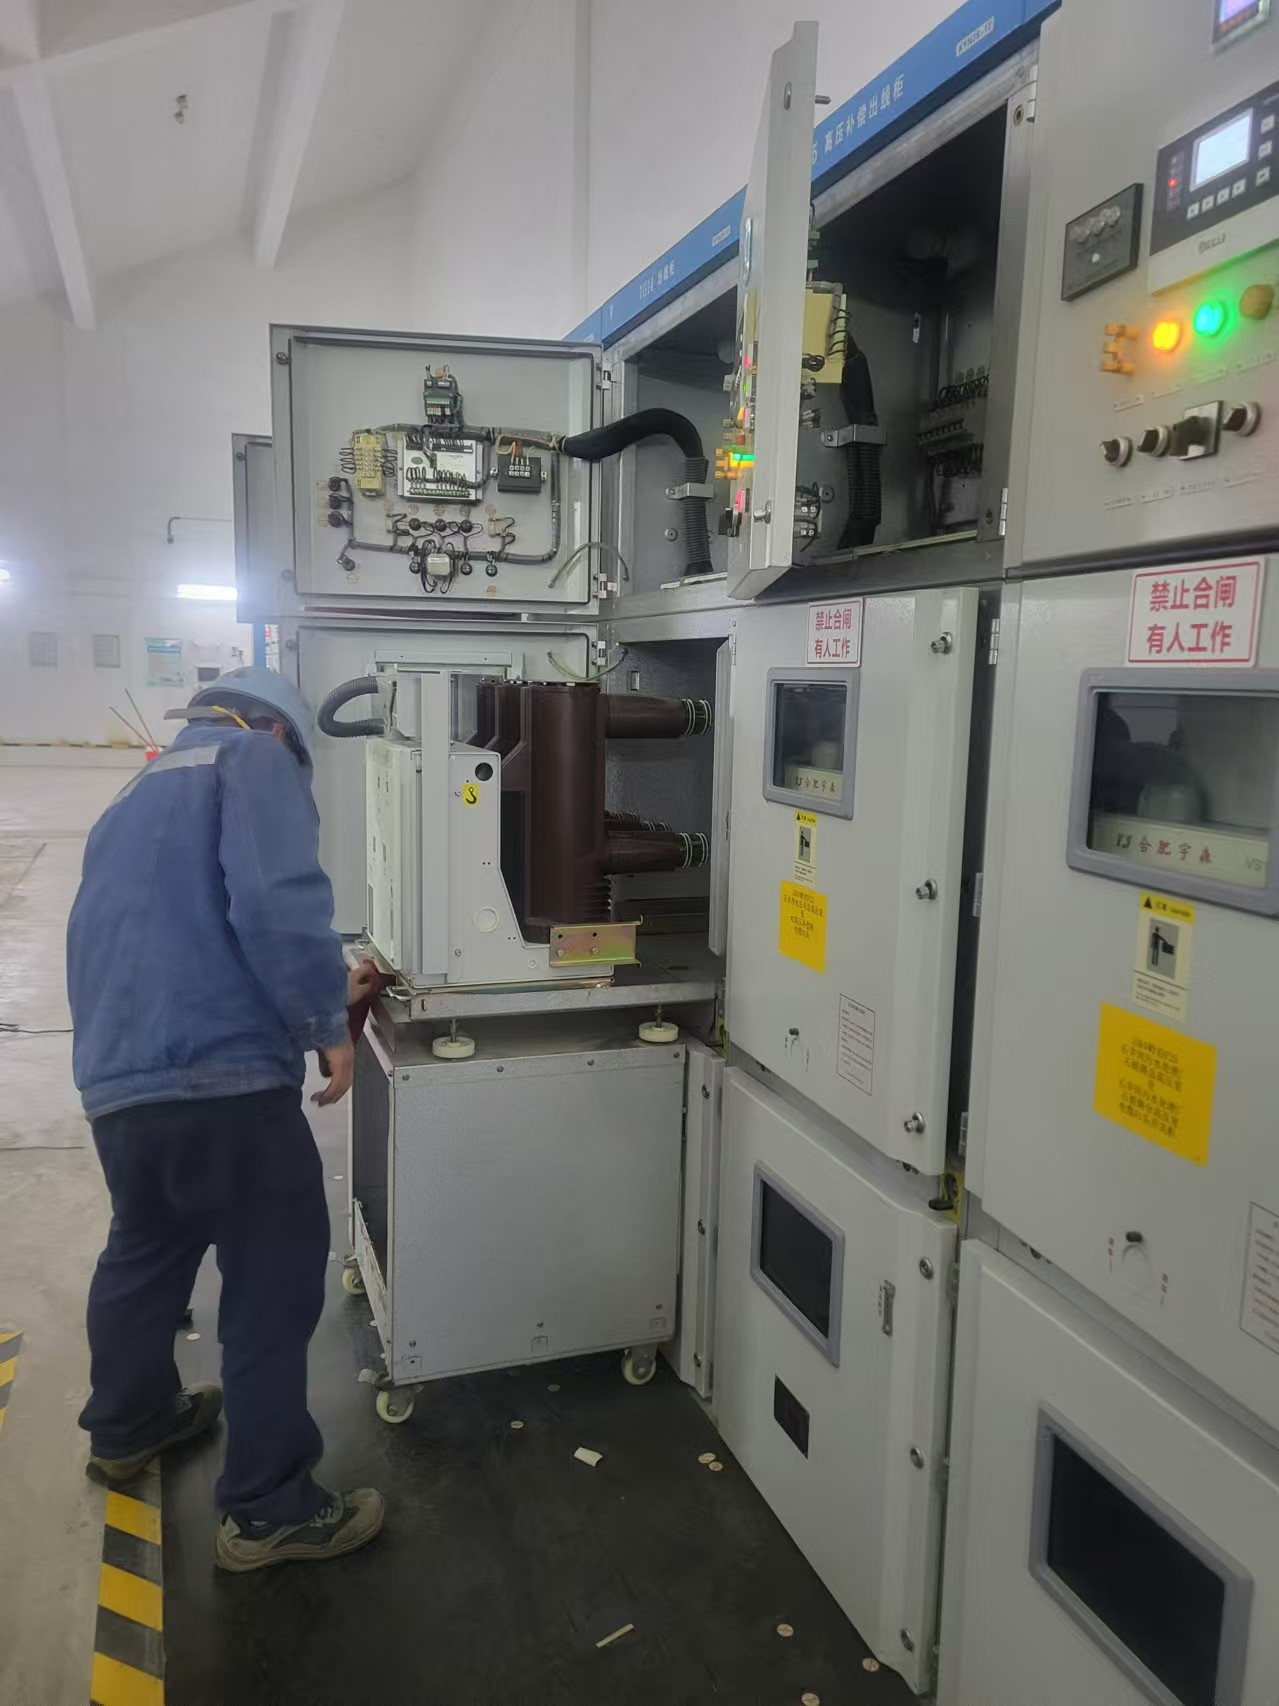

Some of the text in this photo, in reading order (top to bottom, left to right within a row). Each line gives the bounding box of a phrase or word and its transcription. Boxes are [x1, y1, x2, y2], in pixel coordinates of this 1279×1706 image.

[824, 73, 905, 156] 高压补偿出线柜
[1149, 574, 1238, 613] 禁止合闸
[815, 608, 852, 632] 禁止合闸
[1146, 620, 1233, 655] 有人工作
[814, 638, 850, 659] 有人工作
